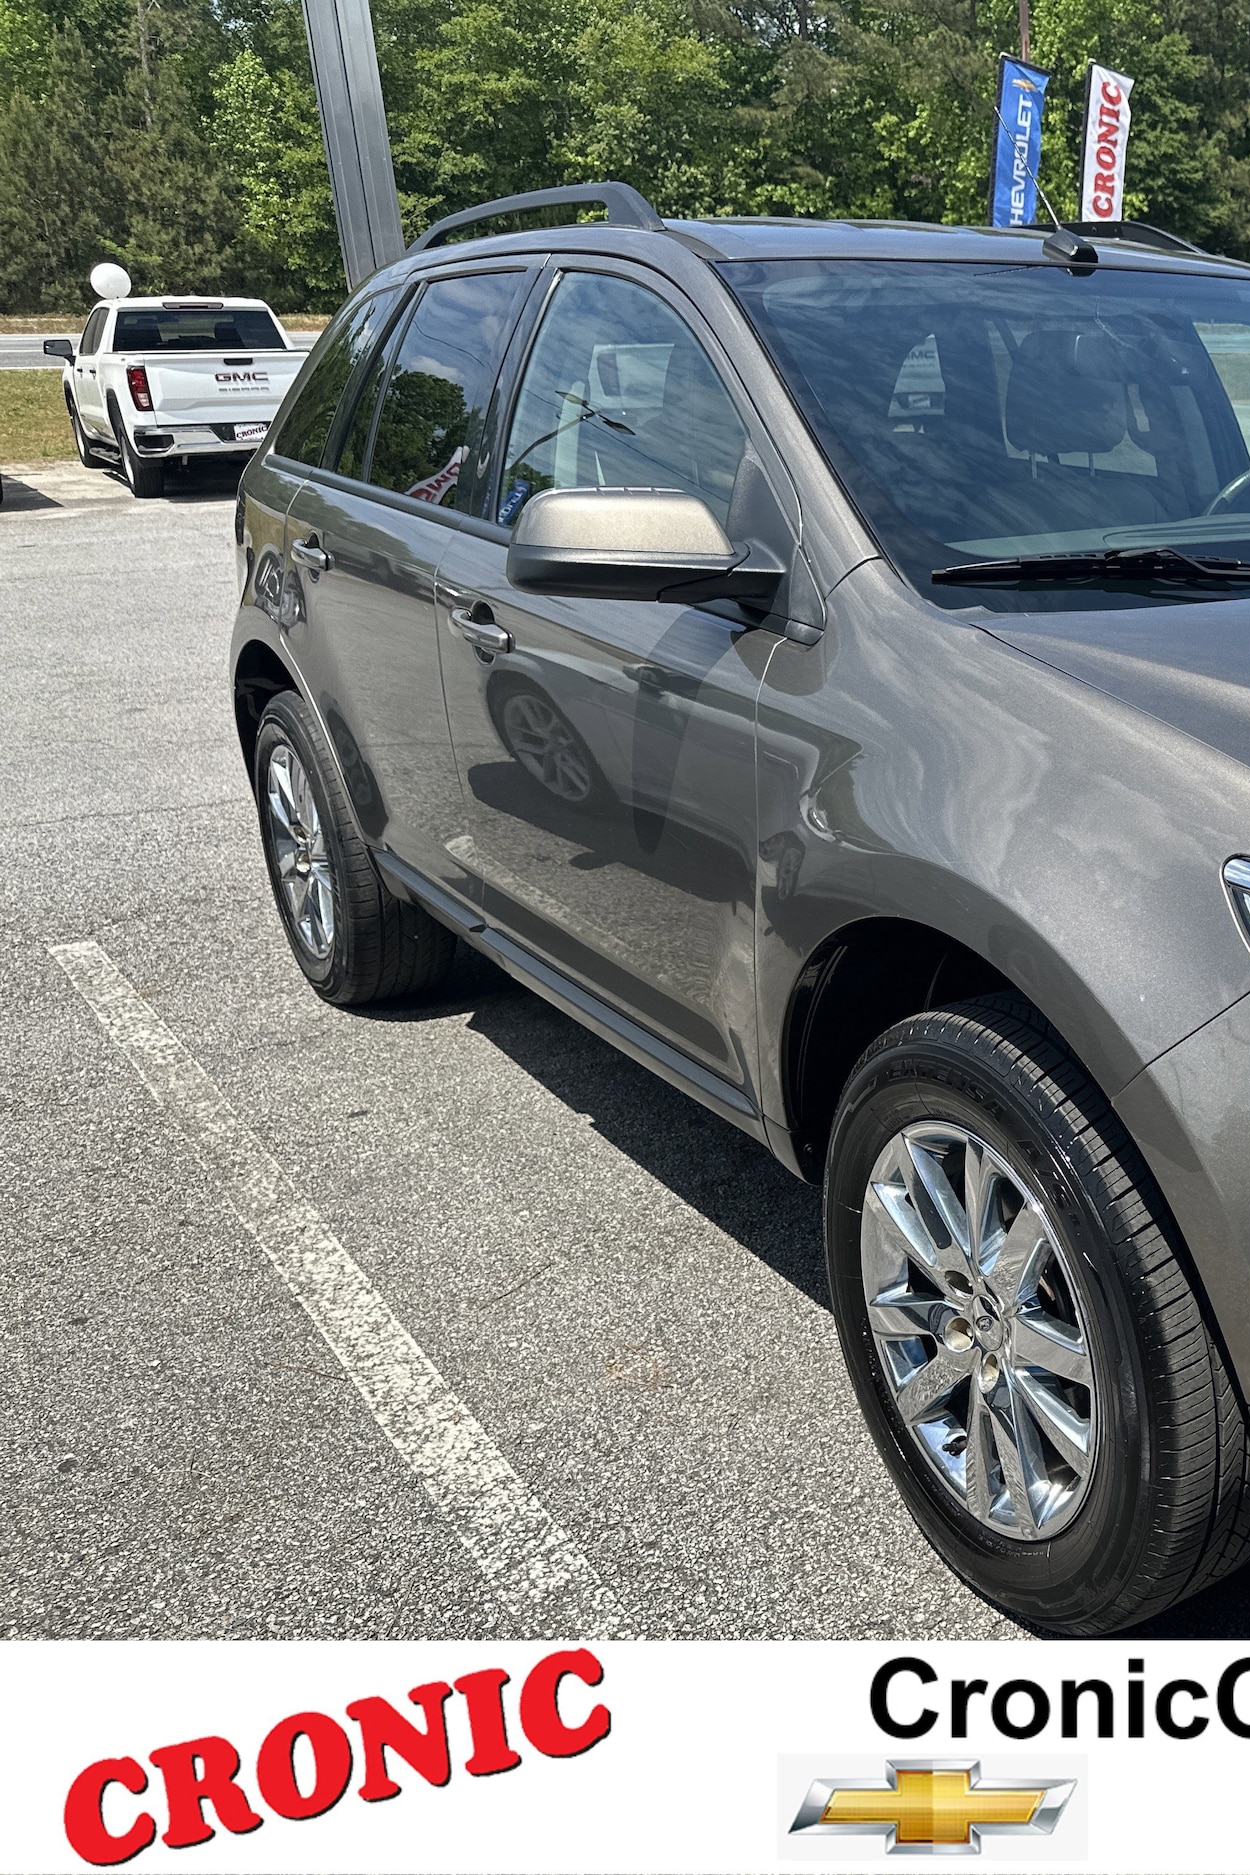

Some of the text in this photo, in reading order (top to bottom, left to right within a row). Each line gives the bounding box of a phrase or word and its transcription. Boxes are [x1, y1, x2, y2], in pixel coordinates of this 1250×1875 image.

[1010, 94, 1033, 227] HEVROLET
[1092, 81, 1122, 219] CRONIC
[214, 372, 269, 382] GMC
[236, 425, 269, 439] CRONIC
